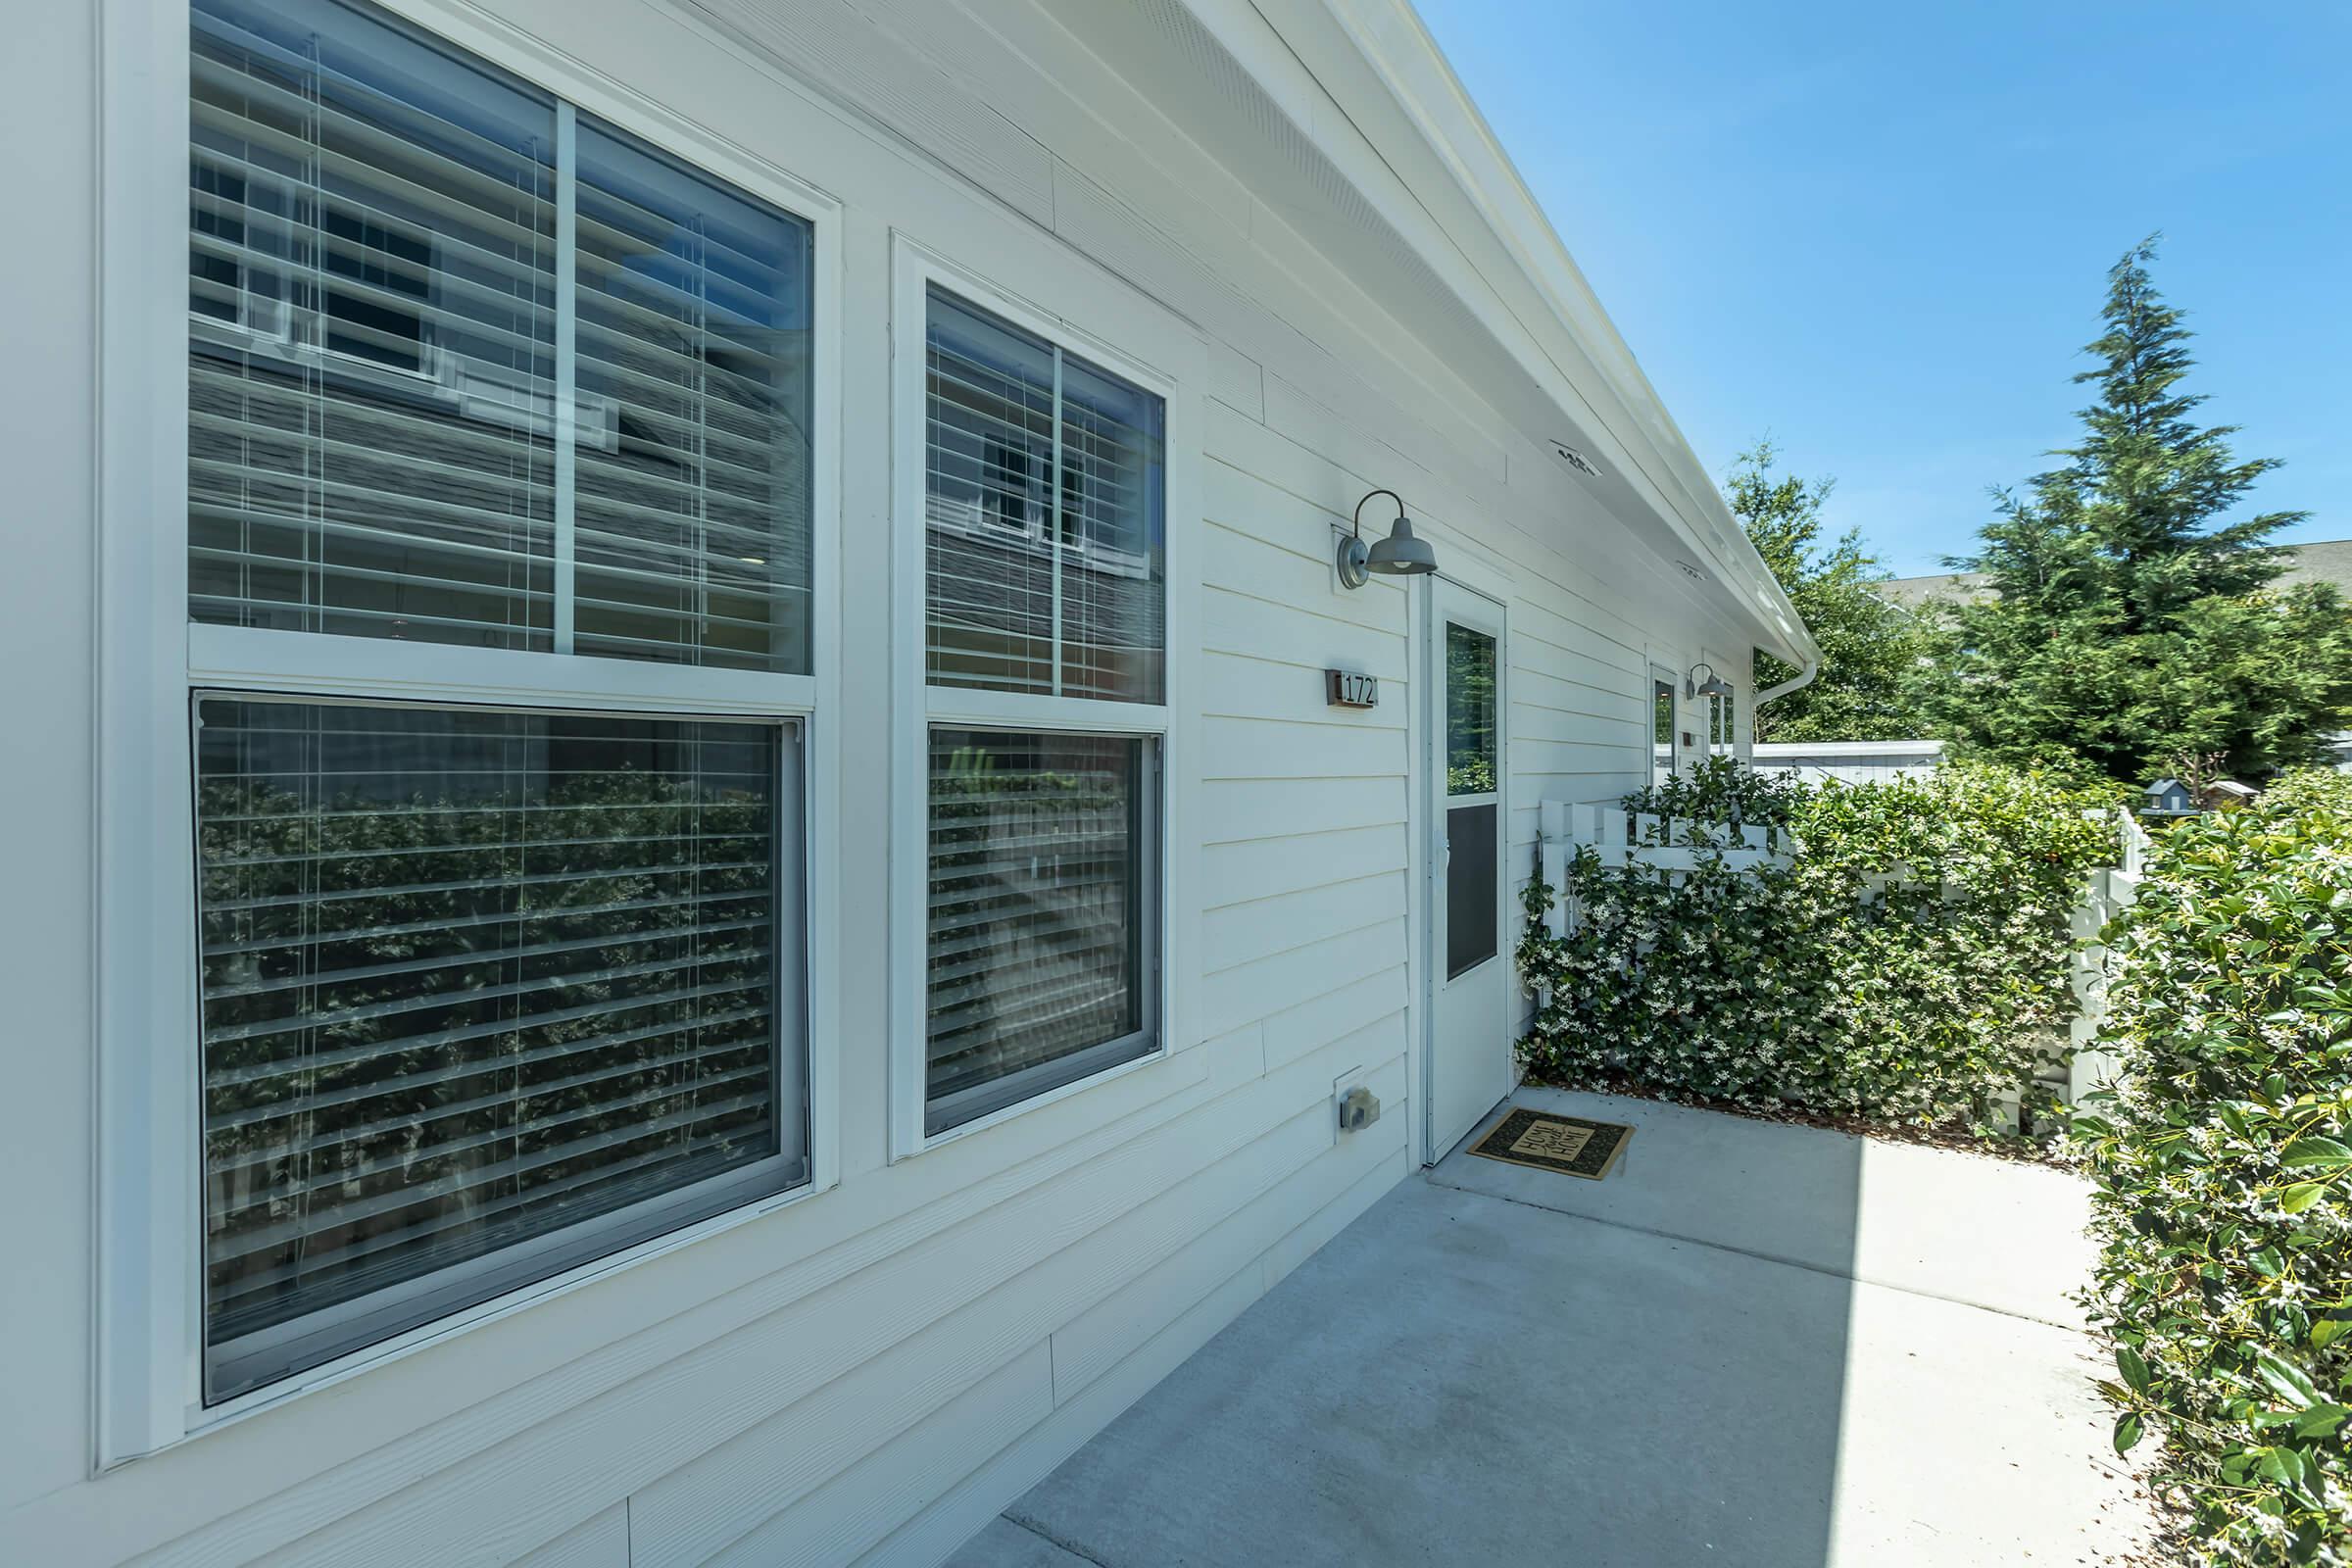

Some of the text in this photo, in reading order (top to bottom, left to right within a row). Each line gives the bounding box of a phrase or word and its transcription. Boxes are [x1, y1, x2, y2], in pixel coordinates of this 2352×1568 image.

[1346, 674, 1374, 704] 172
[1517, 1125, 1555, 1151] HOME
[1551, 1131, 1588, 1156] HOME
